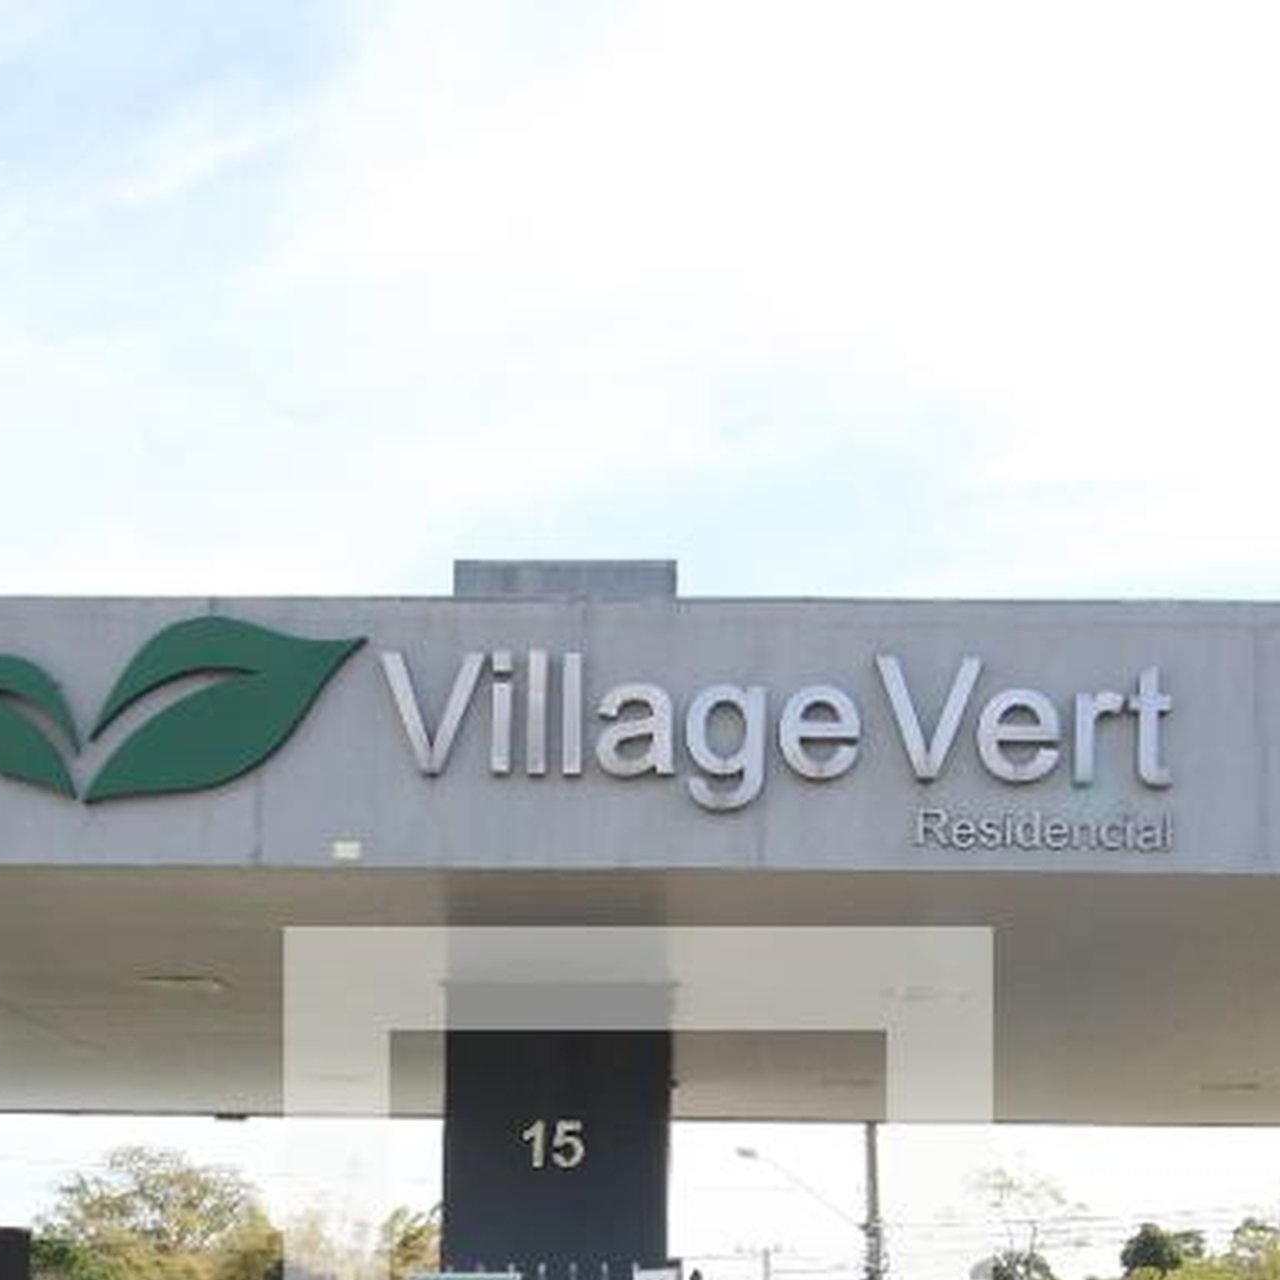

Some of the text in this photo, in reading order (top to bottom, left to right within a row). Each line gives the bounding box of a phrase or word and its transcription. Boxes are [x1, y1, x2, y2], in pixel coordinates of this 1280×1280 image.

[379, 647, 1173, 813] Village Vert
[914, 806, 1174, 852] Residencial
[521, 1119, 585, 1168] 15
